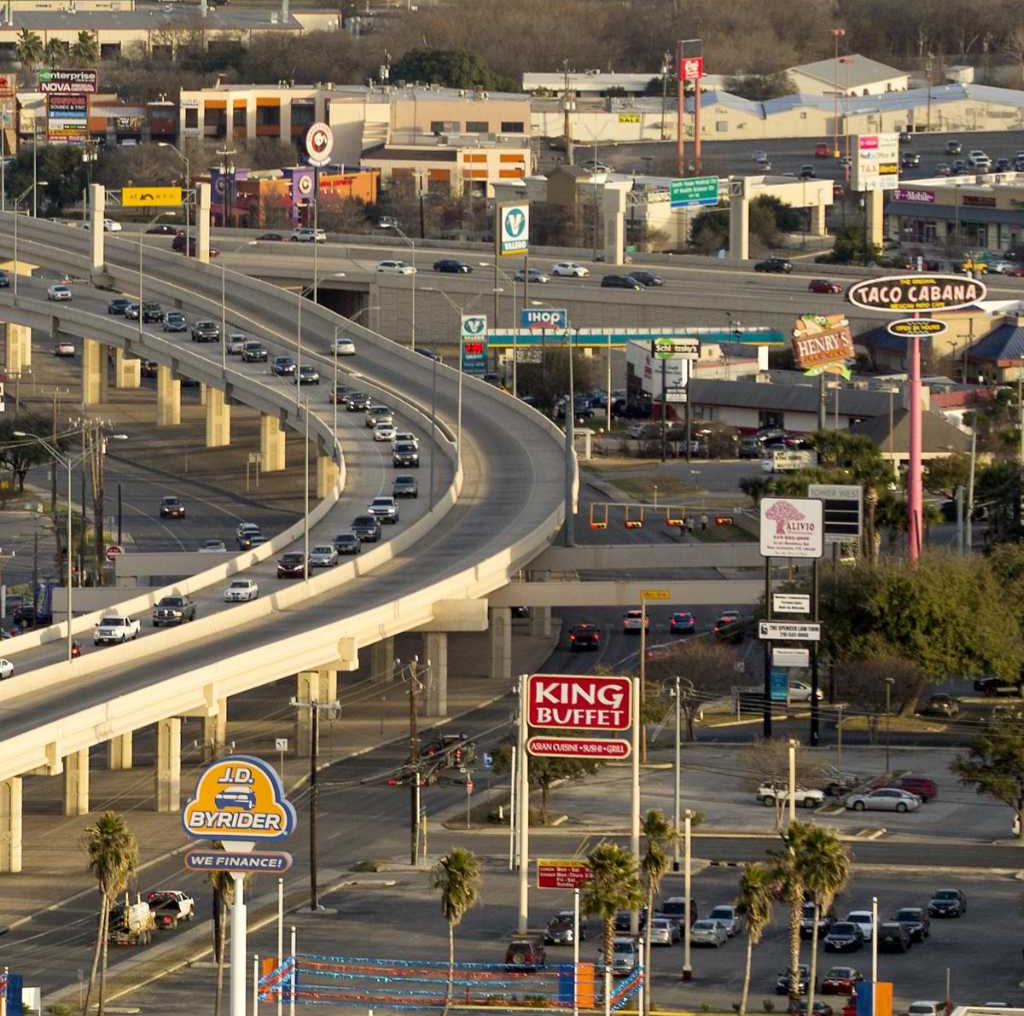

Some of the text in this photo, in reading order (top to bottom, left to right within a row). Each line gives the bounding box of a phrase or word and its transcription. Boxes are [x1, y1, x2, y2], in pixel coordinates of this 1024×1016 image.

[41, 83, 71, 91] NOVA
[894, 190, 934, 202] T-Mobile
[858, 284, 977, 303] TACO CABANA
[528, 312, 560, 324] IHOP
[796, 331, 850, 357] HENRY'S
[786, 522, 815, 531] ALIVIO
[535, 681, 625, 709] KING
[536, 707, 625, 726] BUFFET
[531, 742, 624, 754] ASIAN CUISINE SUSHI GRILL
[217, 767, 254, 784] J.D.
[189, 811, 282, 830] BYRIDER
[191, 856, 282, 867] WE FINANCE!
